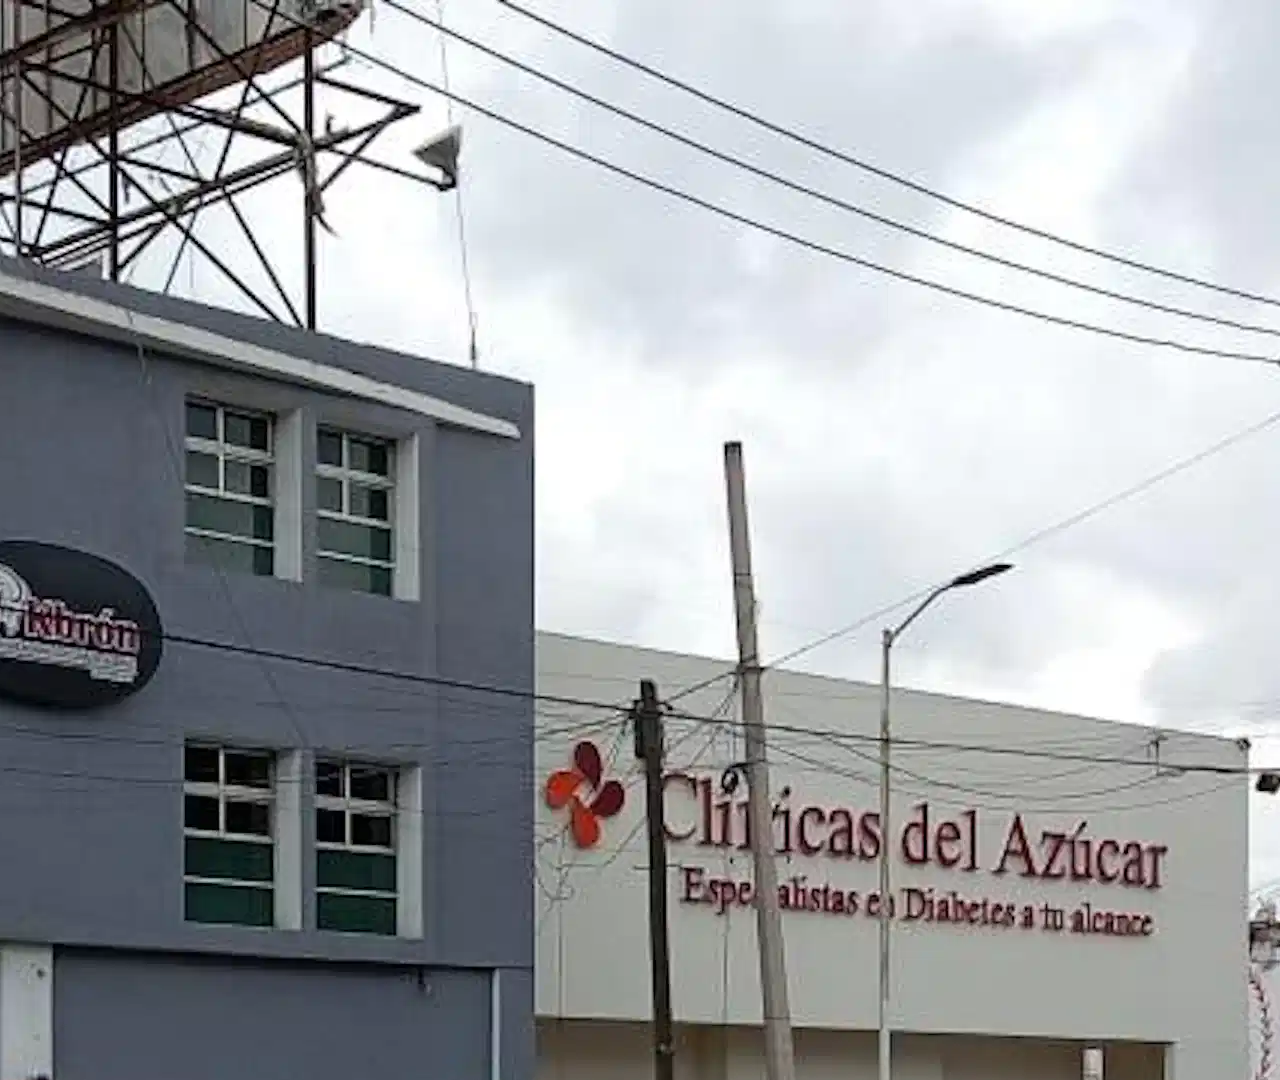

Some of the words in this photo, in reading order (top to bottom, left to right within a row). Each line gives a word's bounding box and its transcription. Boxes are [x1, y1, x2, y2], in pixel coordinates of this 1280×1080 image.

[900, 801, 979, 872] del
[991, 812, 1169, 889] Azúcar
[680, 867, 858, 916] Espealistas
[899, 888, 1016, 926] Diabetes
[1022, 905, 1035, 929] a
[1038, 902, 1065, 931] tu
[1071, 903, 1154, 937] alcance
